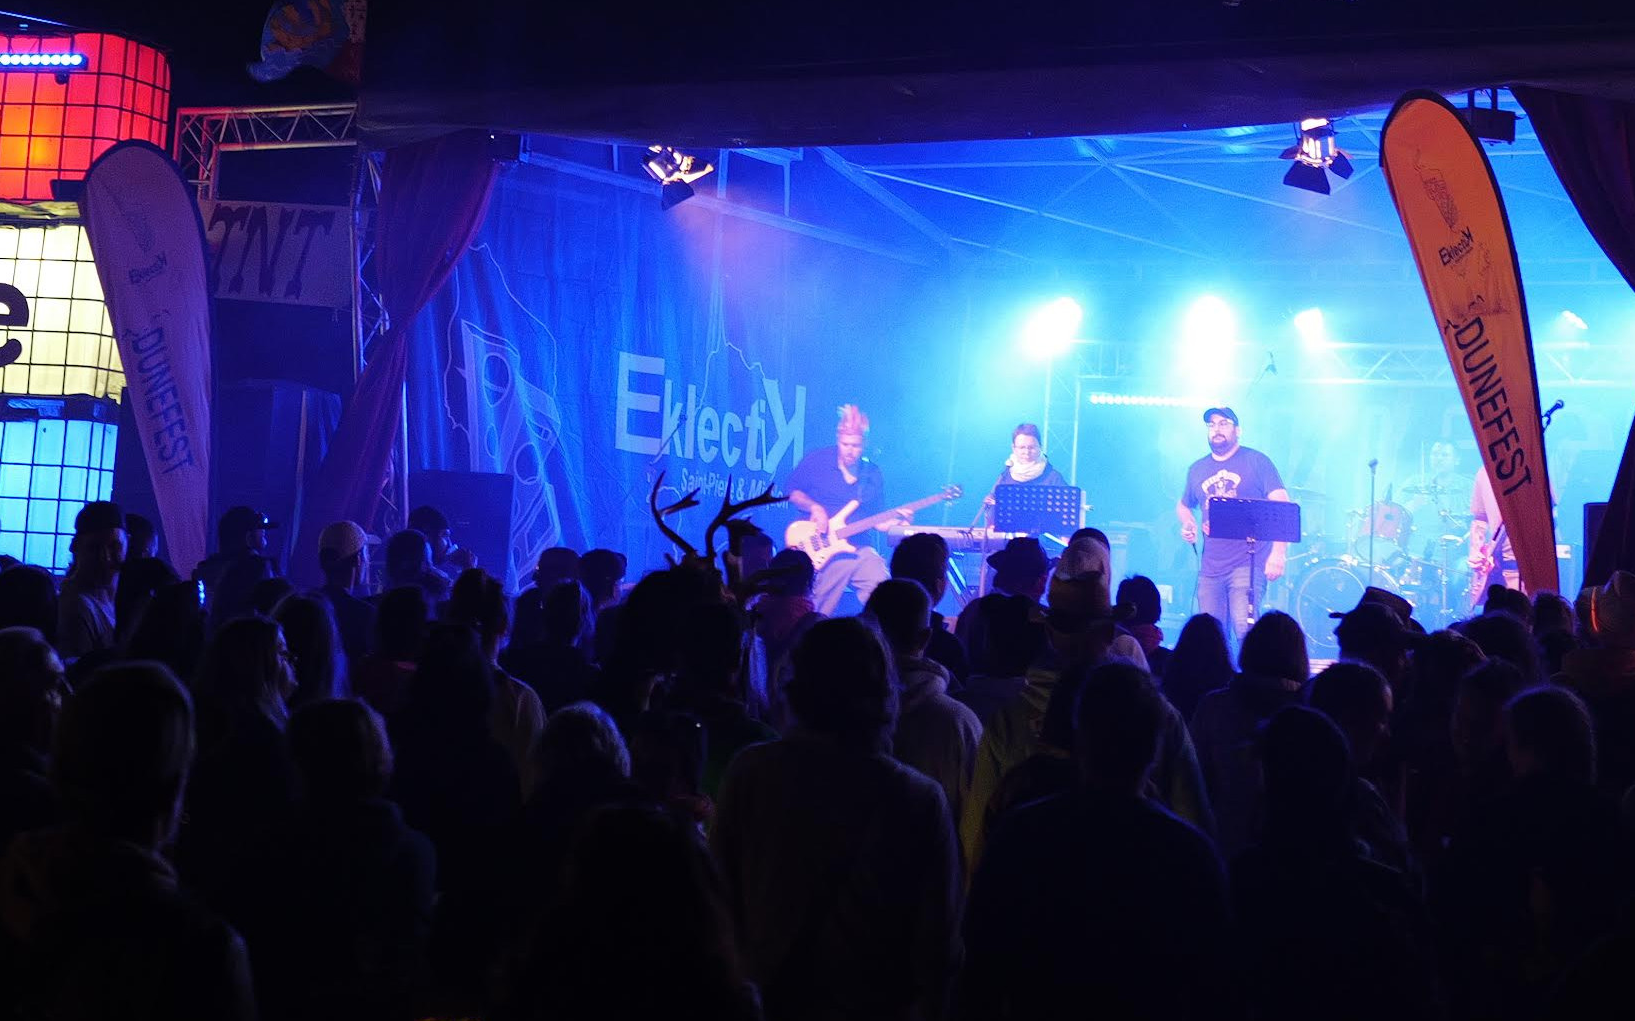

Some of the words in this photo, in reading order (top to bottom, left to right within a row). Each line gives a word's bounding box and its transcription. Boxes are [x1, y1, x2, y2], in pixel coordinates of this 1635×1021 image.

[208, 203, 335, 299] TNT
[132, 326, 195, 474] DUNEFEST
[1454, 316, 1533, 497] DUNEFEST
[736, 478, 746, 502] &
